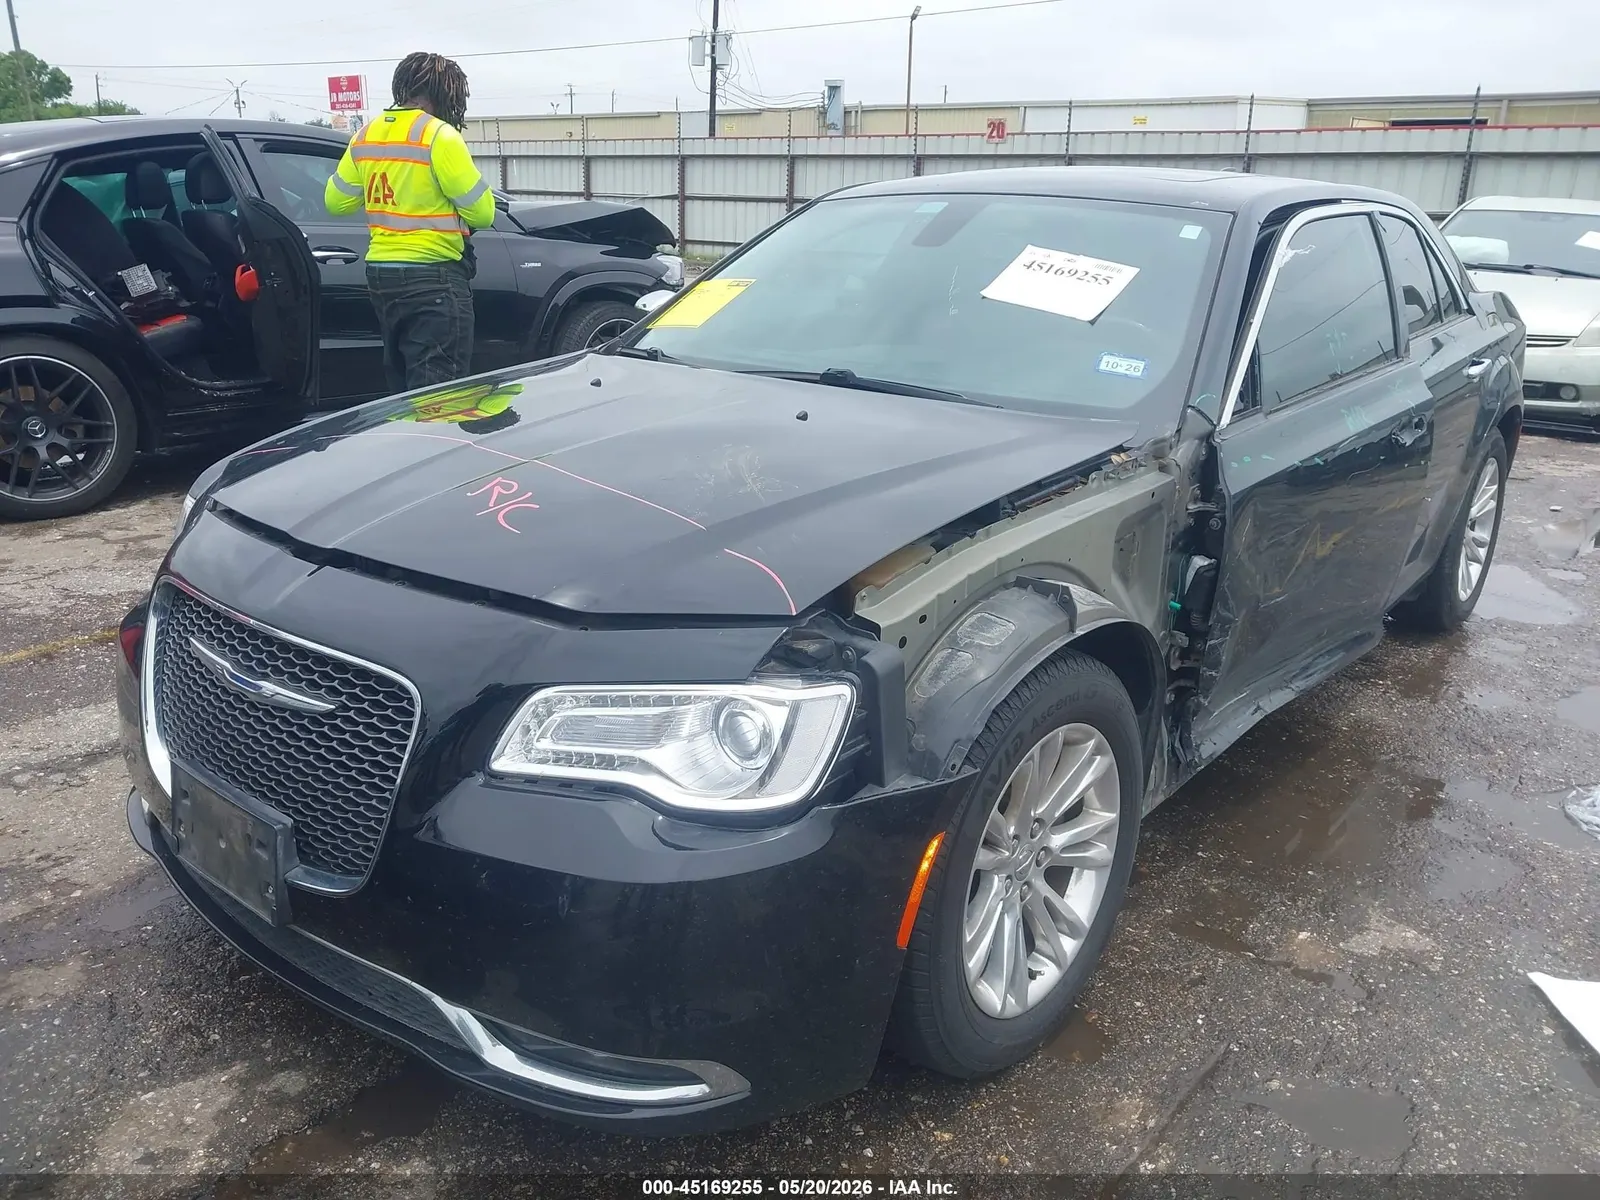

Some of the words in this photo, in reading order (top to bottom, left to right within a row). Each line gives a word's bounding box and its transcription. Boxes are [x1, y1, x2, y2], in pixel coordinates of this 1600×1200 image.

[338, 91, 360, 102] MOTORS
[987, 121, 1005, 139] 20
[1023, 259, 1114, 286] 45169255
[1030, 689, 1080, 734] Ascend
